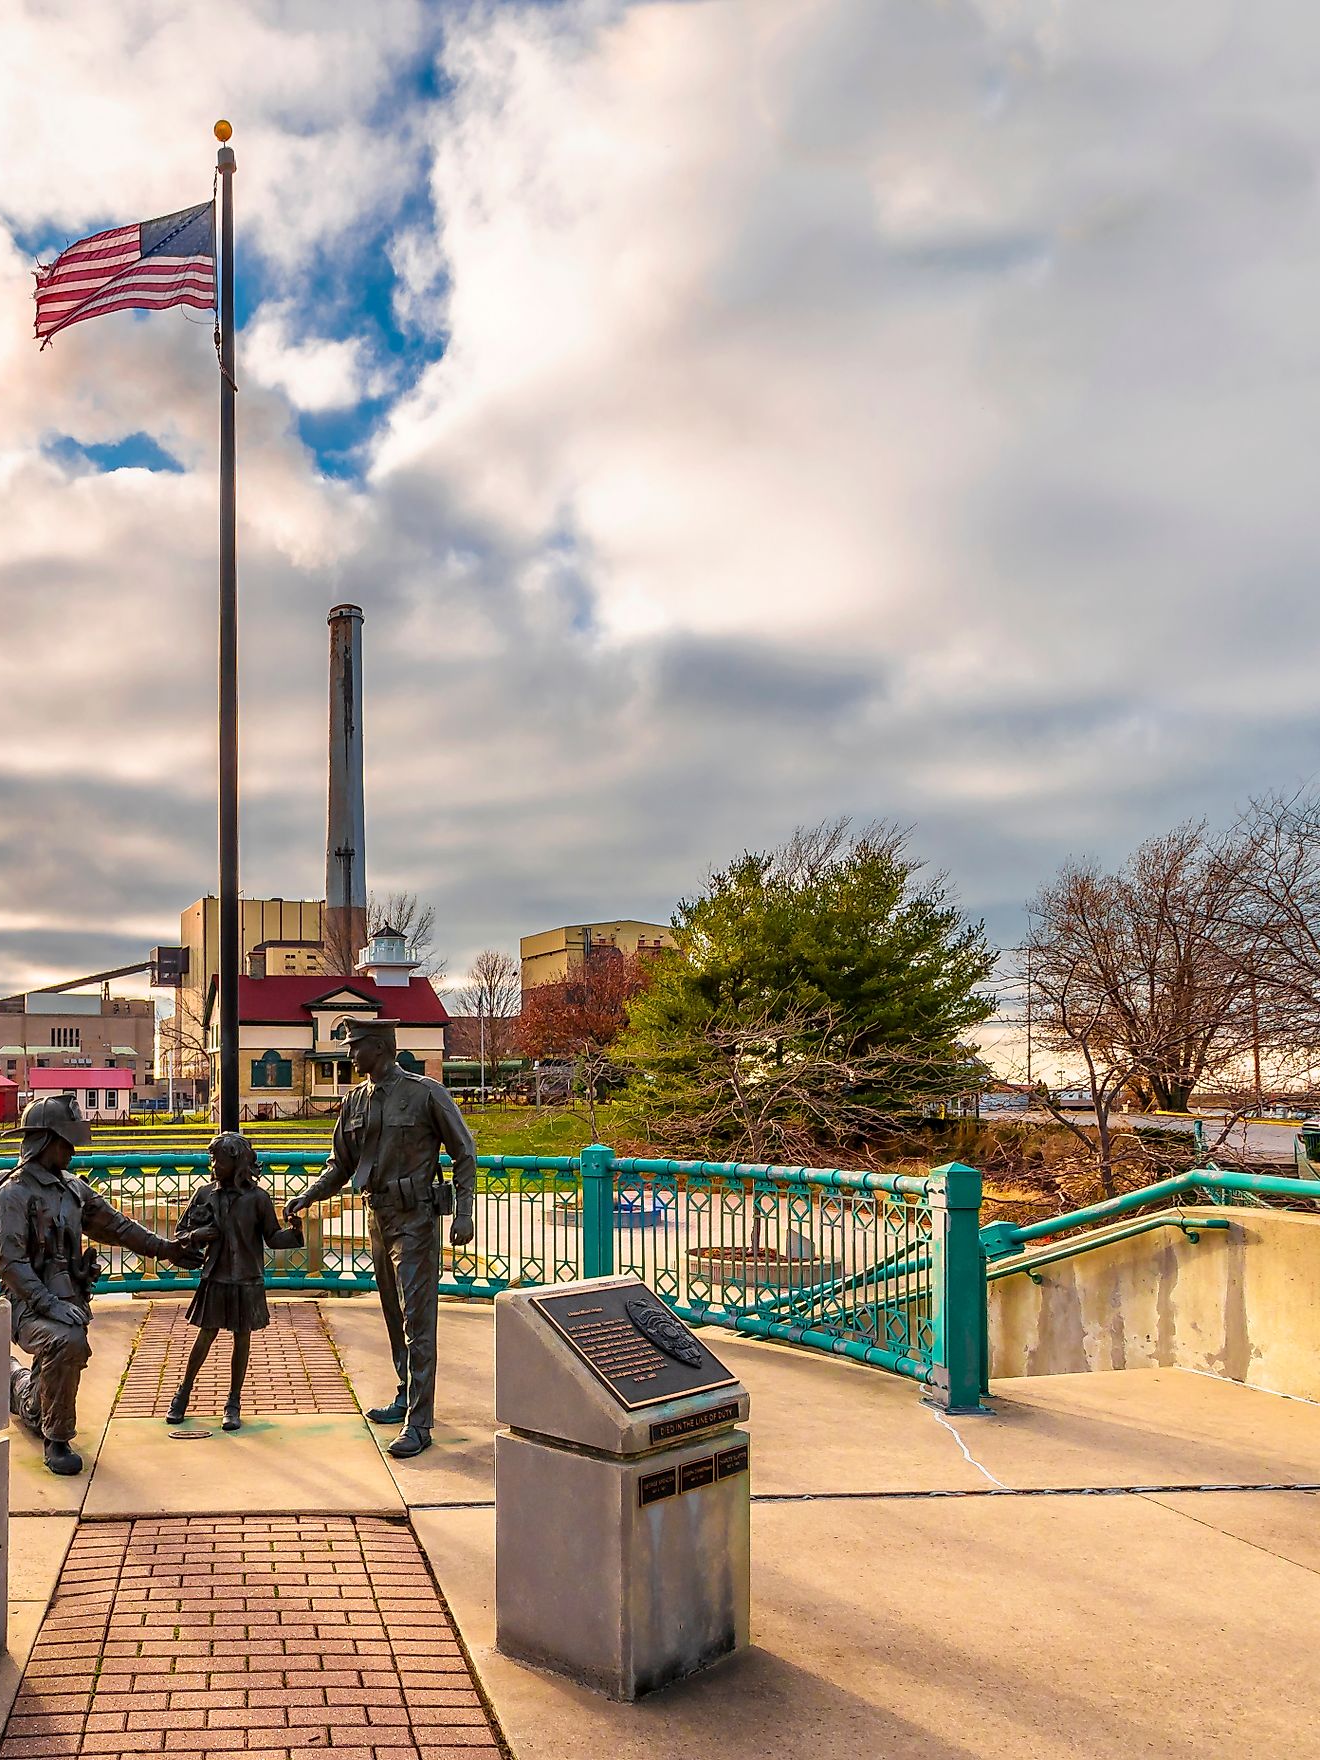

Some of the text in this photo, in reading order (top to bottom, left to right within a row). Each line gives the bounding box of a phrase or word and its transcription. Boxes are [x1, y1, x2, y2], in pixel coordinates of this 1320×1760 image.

[660, 1408, 733, 1436] DIED IN THE LINE OF DUTY
